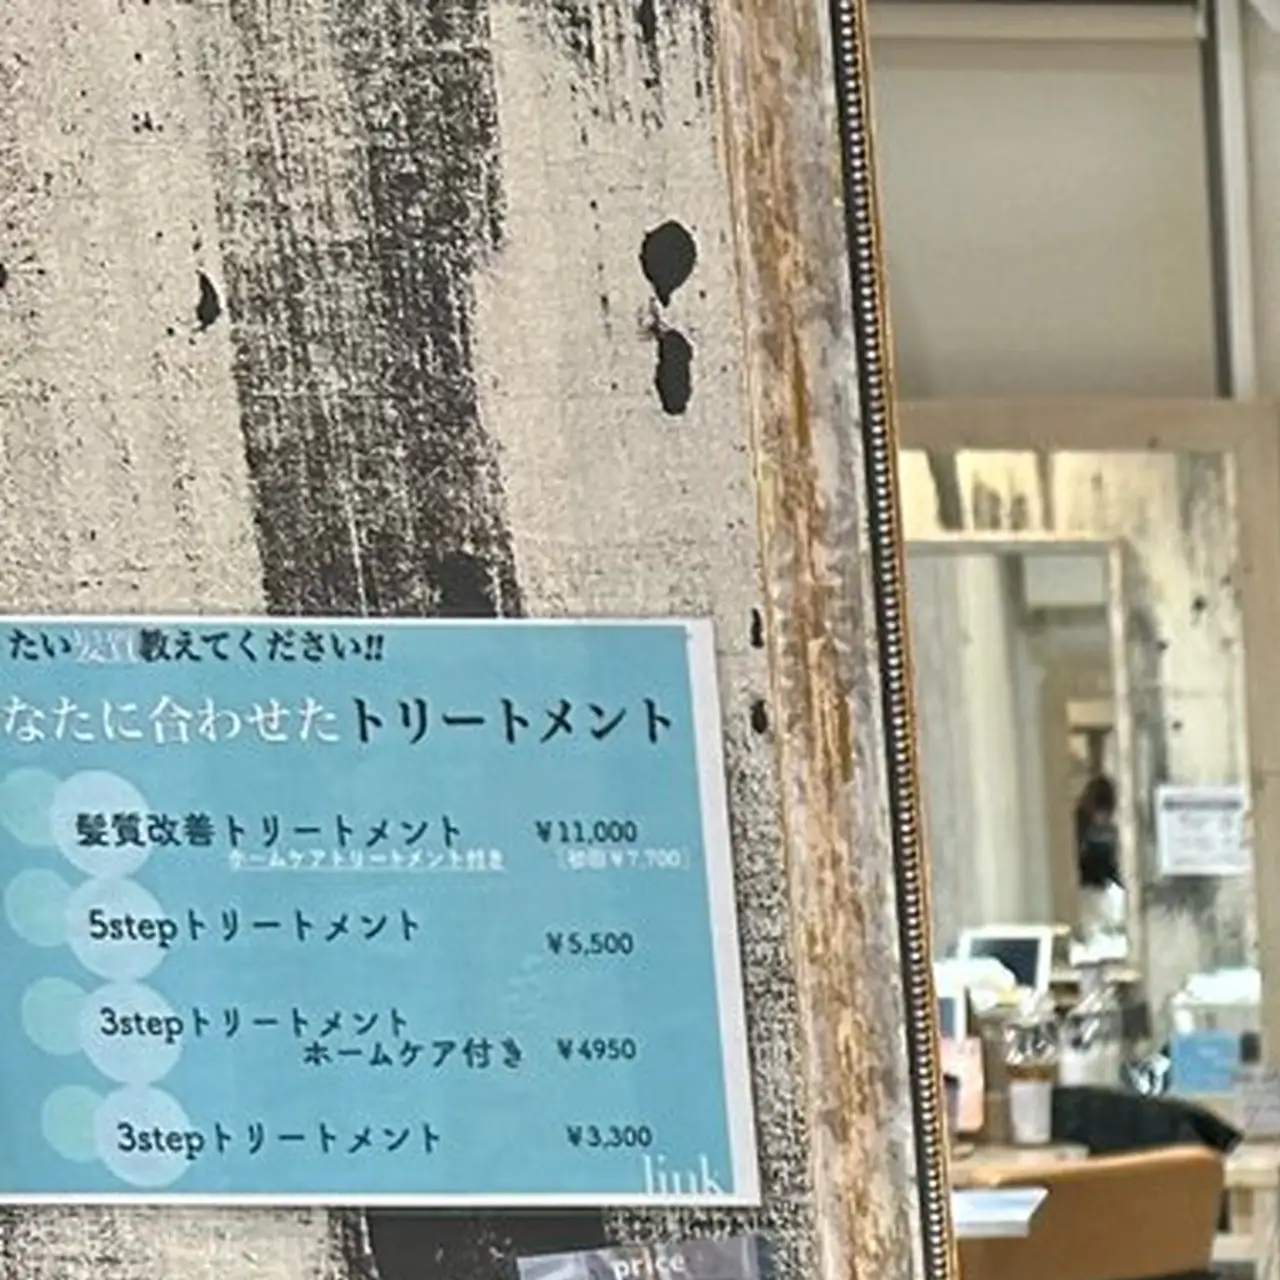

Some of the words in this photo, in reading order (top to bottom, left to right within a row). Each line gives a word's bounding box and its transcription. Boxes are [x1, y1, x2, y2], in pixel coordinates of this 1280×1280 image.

[76, 812, 461, 847] 髪質改善トリートメント
[546, 932, 634, 955] ¥5,500
[303, 1038, 523, 1069] ホームケア付き
